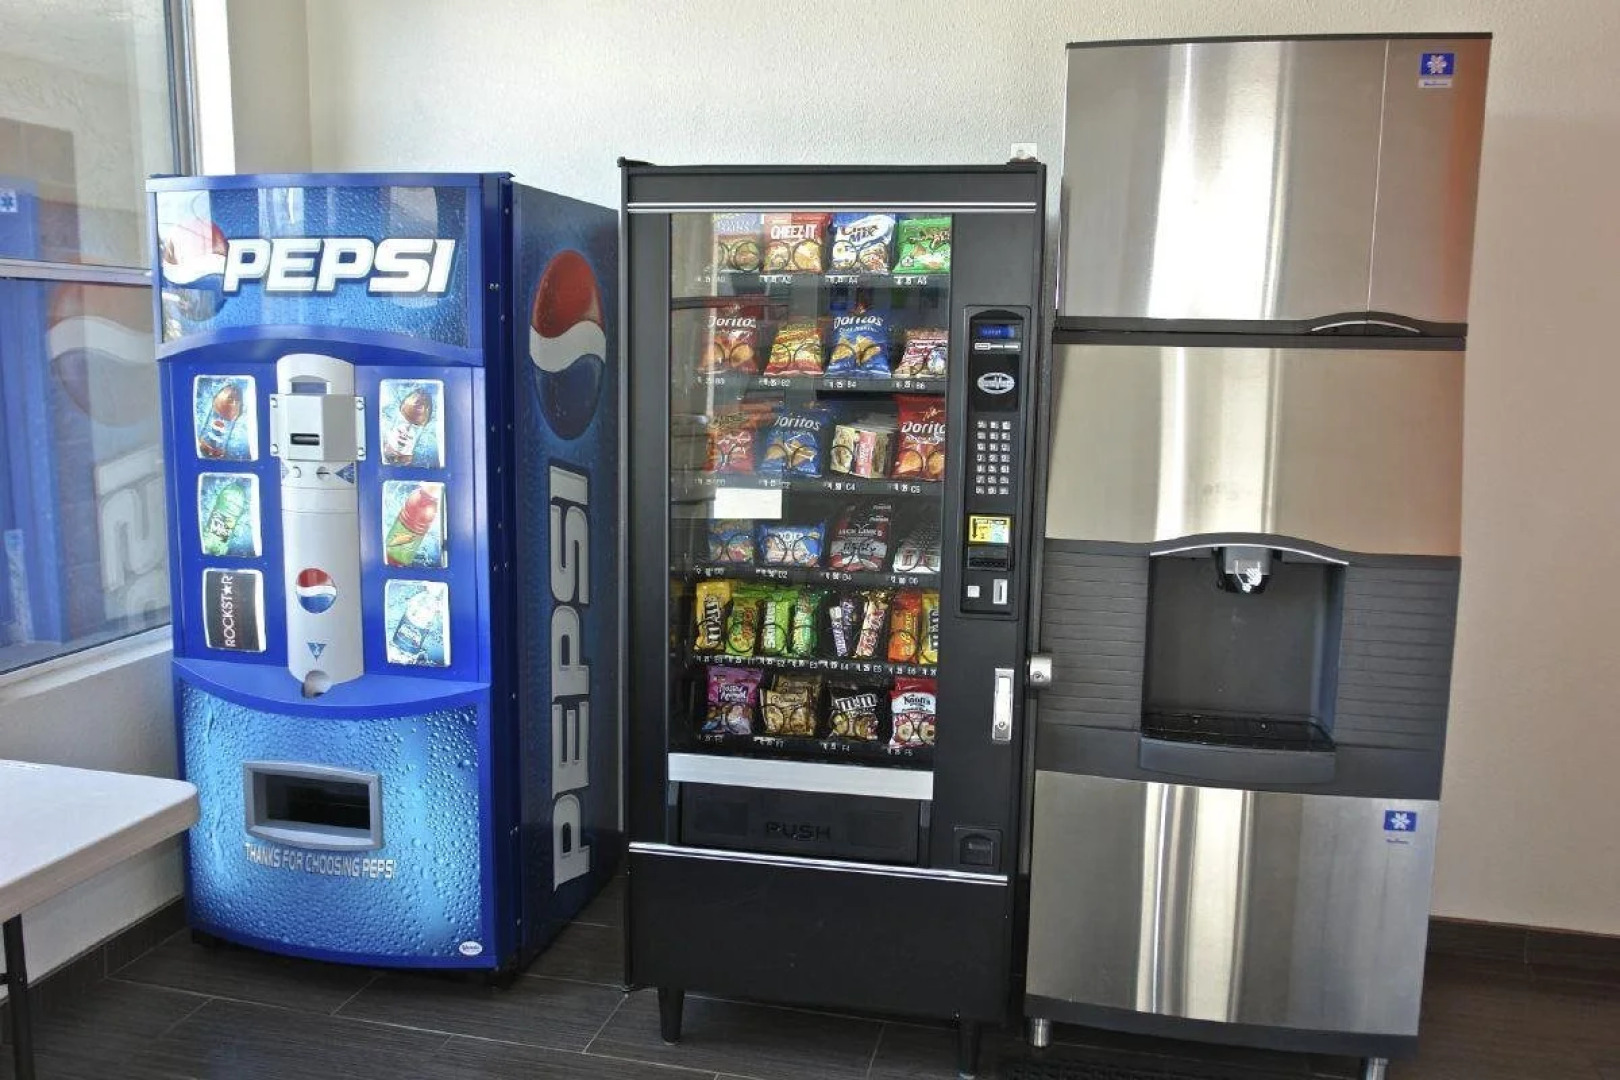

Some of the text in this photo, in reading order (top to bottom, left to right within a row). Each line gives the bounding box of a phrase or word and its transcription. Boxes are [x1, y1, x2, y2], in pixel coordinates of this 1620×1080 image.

[222, 237, 457, 293] PEPSI
[549, 465, 591, 893] PEPSI
[766, 820, 831, 842] PUSH
[245, 842, 281, 868] THANKS
[281, 849, 303, 870] FOR
[305, 853, 360, 877] CHOOSING
